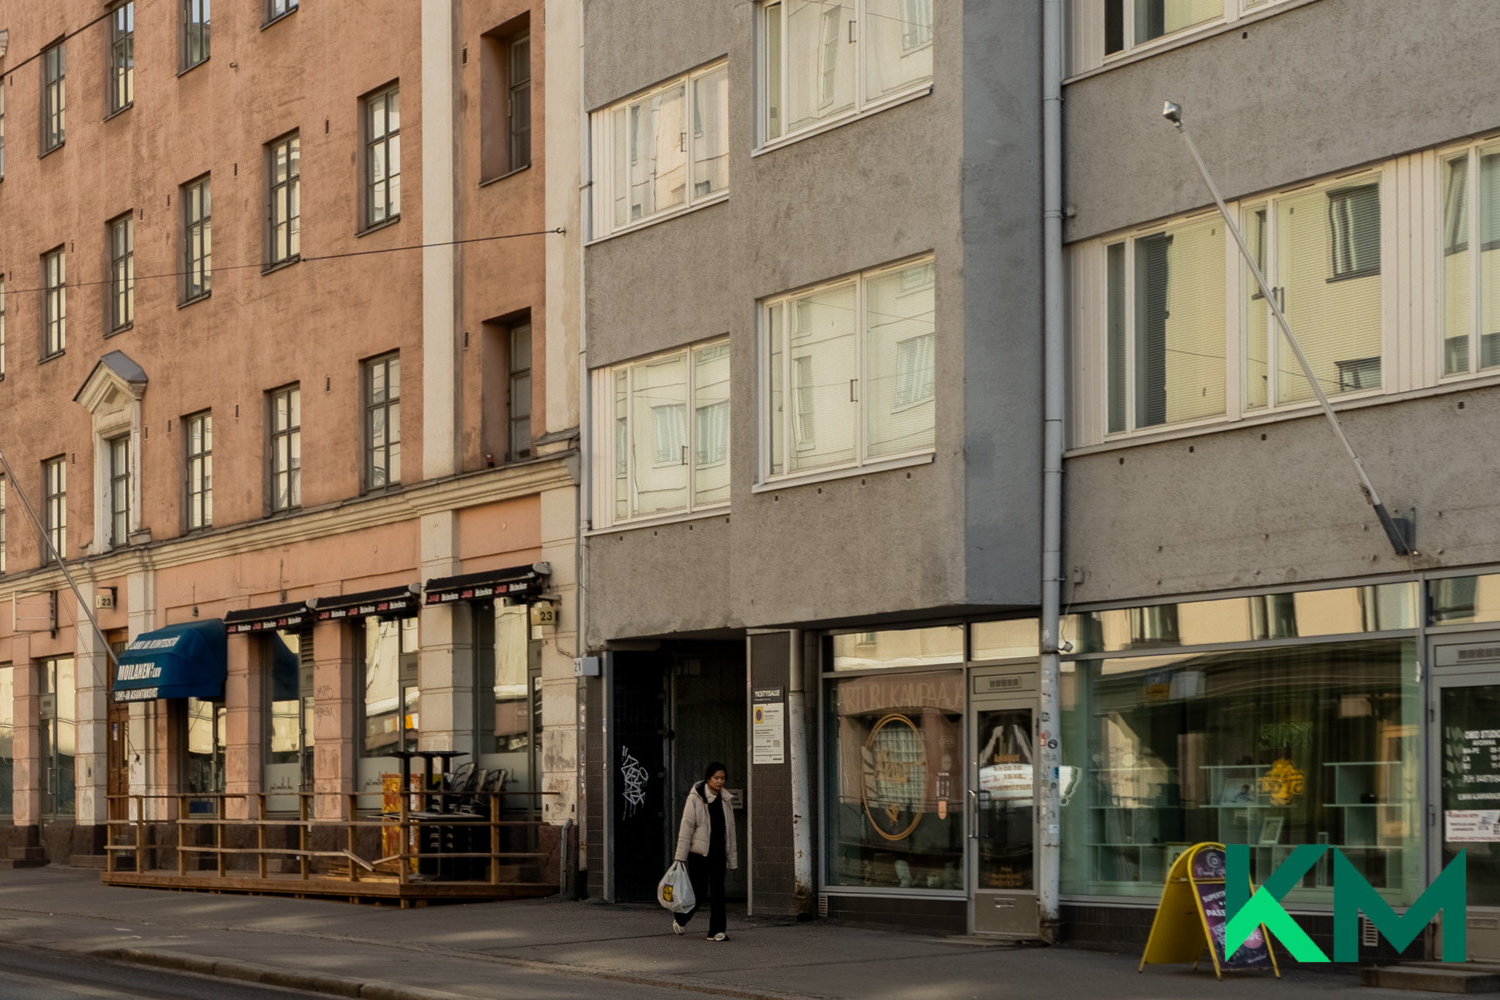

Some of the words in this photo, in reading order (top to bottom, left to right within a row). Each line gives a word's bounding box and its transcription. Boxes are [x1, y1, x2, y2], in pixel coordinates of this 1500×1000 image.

[102, 598, 111, 606] 23
[540, 611, 553, 621] 23
[117, 662, 151, 681] MOILANEN
[574, 661, 581, 672] 21
